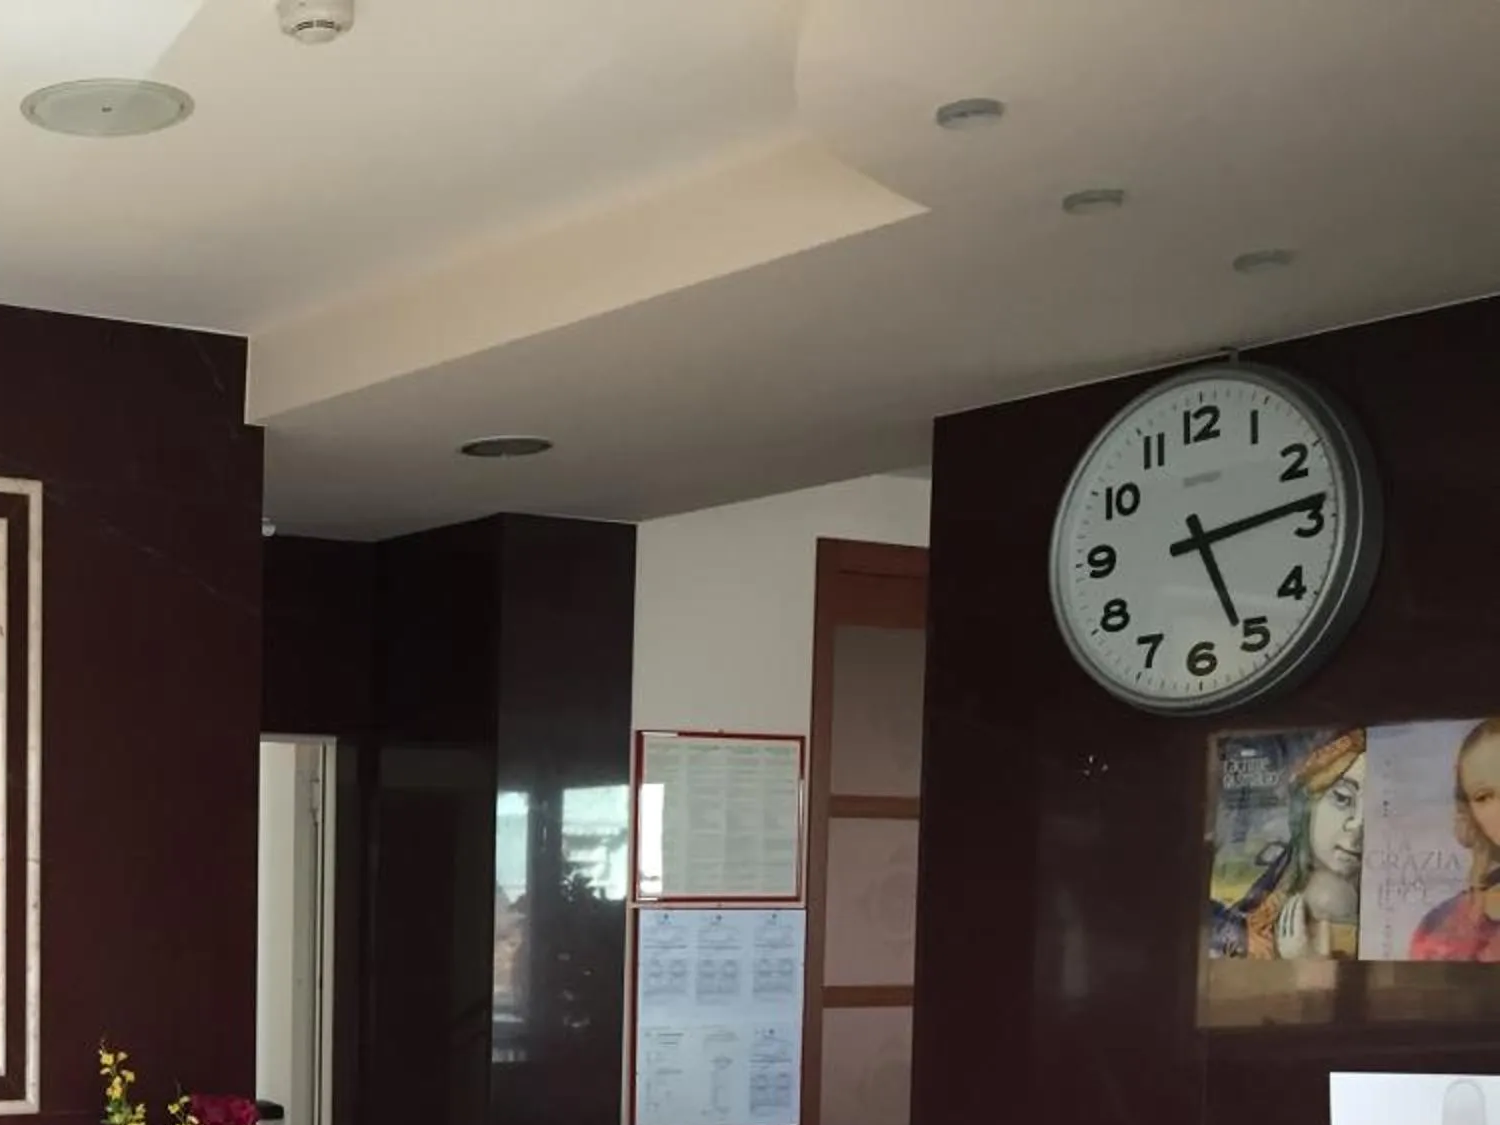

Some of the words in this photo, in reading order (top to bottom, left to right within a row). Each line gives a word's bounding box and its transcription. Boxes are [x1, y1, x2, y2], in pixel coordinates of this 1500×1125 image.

[1183, 405, 1221, 445] 12
[1250, 409, 1259, 445] 1
[1143, 432, 1165, 470] 11
[1279, 443, 1309, 482] 2
[1105, 483, 1141, 520] 10
[1294, 498, 1325, 538] 3
[1087, 545, 1116, 578] 9
[1277, 565, 1307, 600] 4
[1100, 598, 1131, 632] 8
[1137, 633, 1164, 668] 7
[1240, 615, 1271, 652] 5
[1186, 641, 1218, 677] 6
